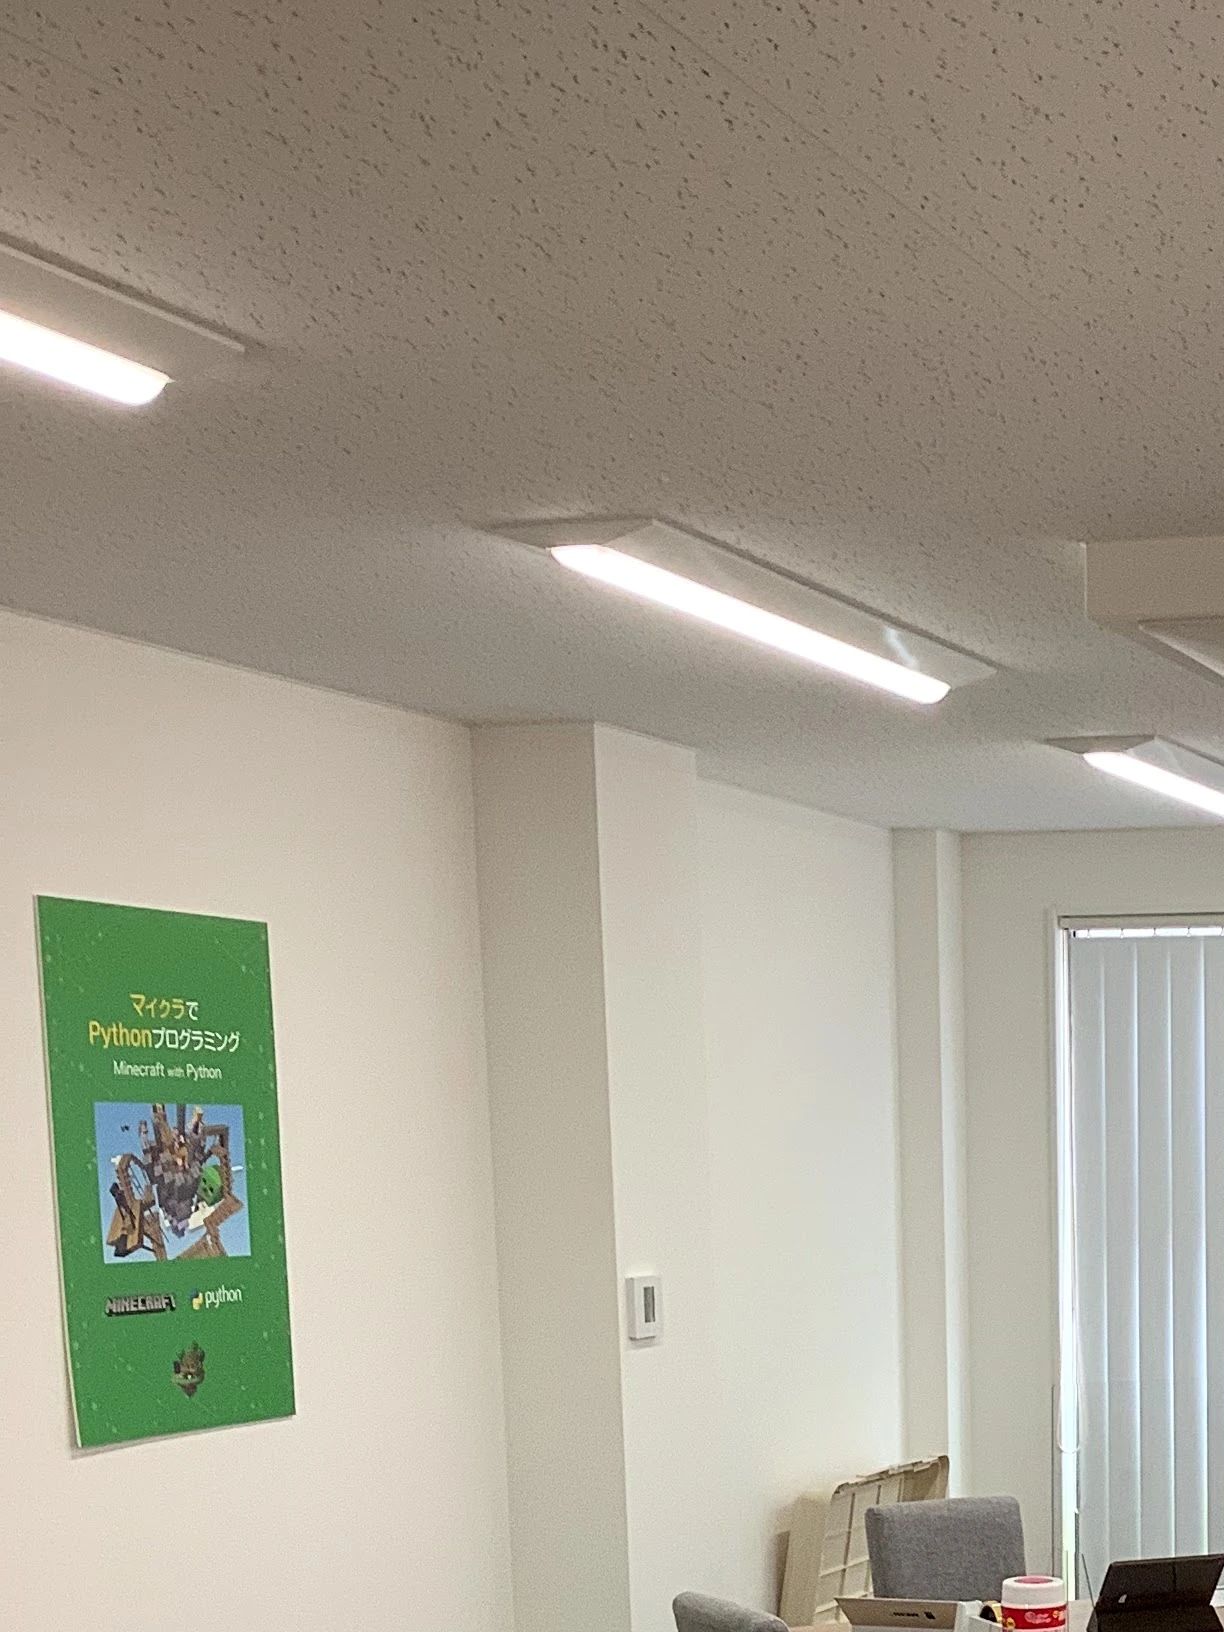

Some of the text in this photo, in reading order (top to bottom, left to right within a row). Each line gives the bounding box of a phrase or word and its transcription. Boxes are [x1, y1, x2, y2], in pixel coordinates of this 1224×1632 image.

[129, 993, 199, 1021] マイクラで
[113, 1059, 223, 1081] Minecraft with Python
[105, 1293, 177, 1316] MINECRAFT
[204, 1284, 243, 1308] python
